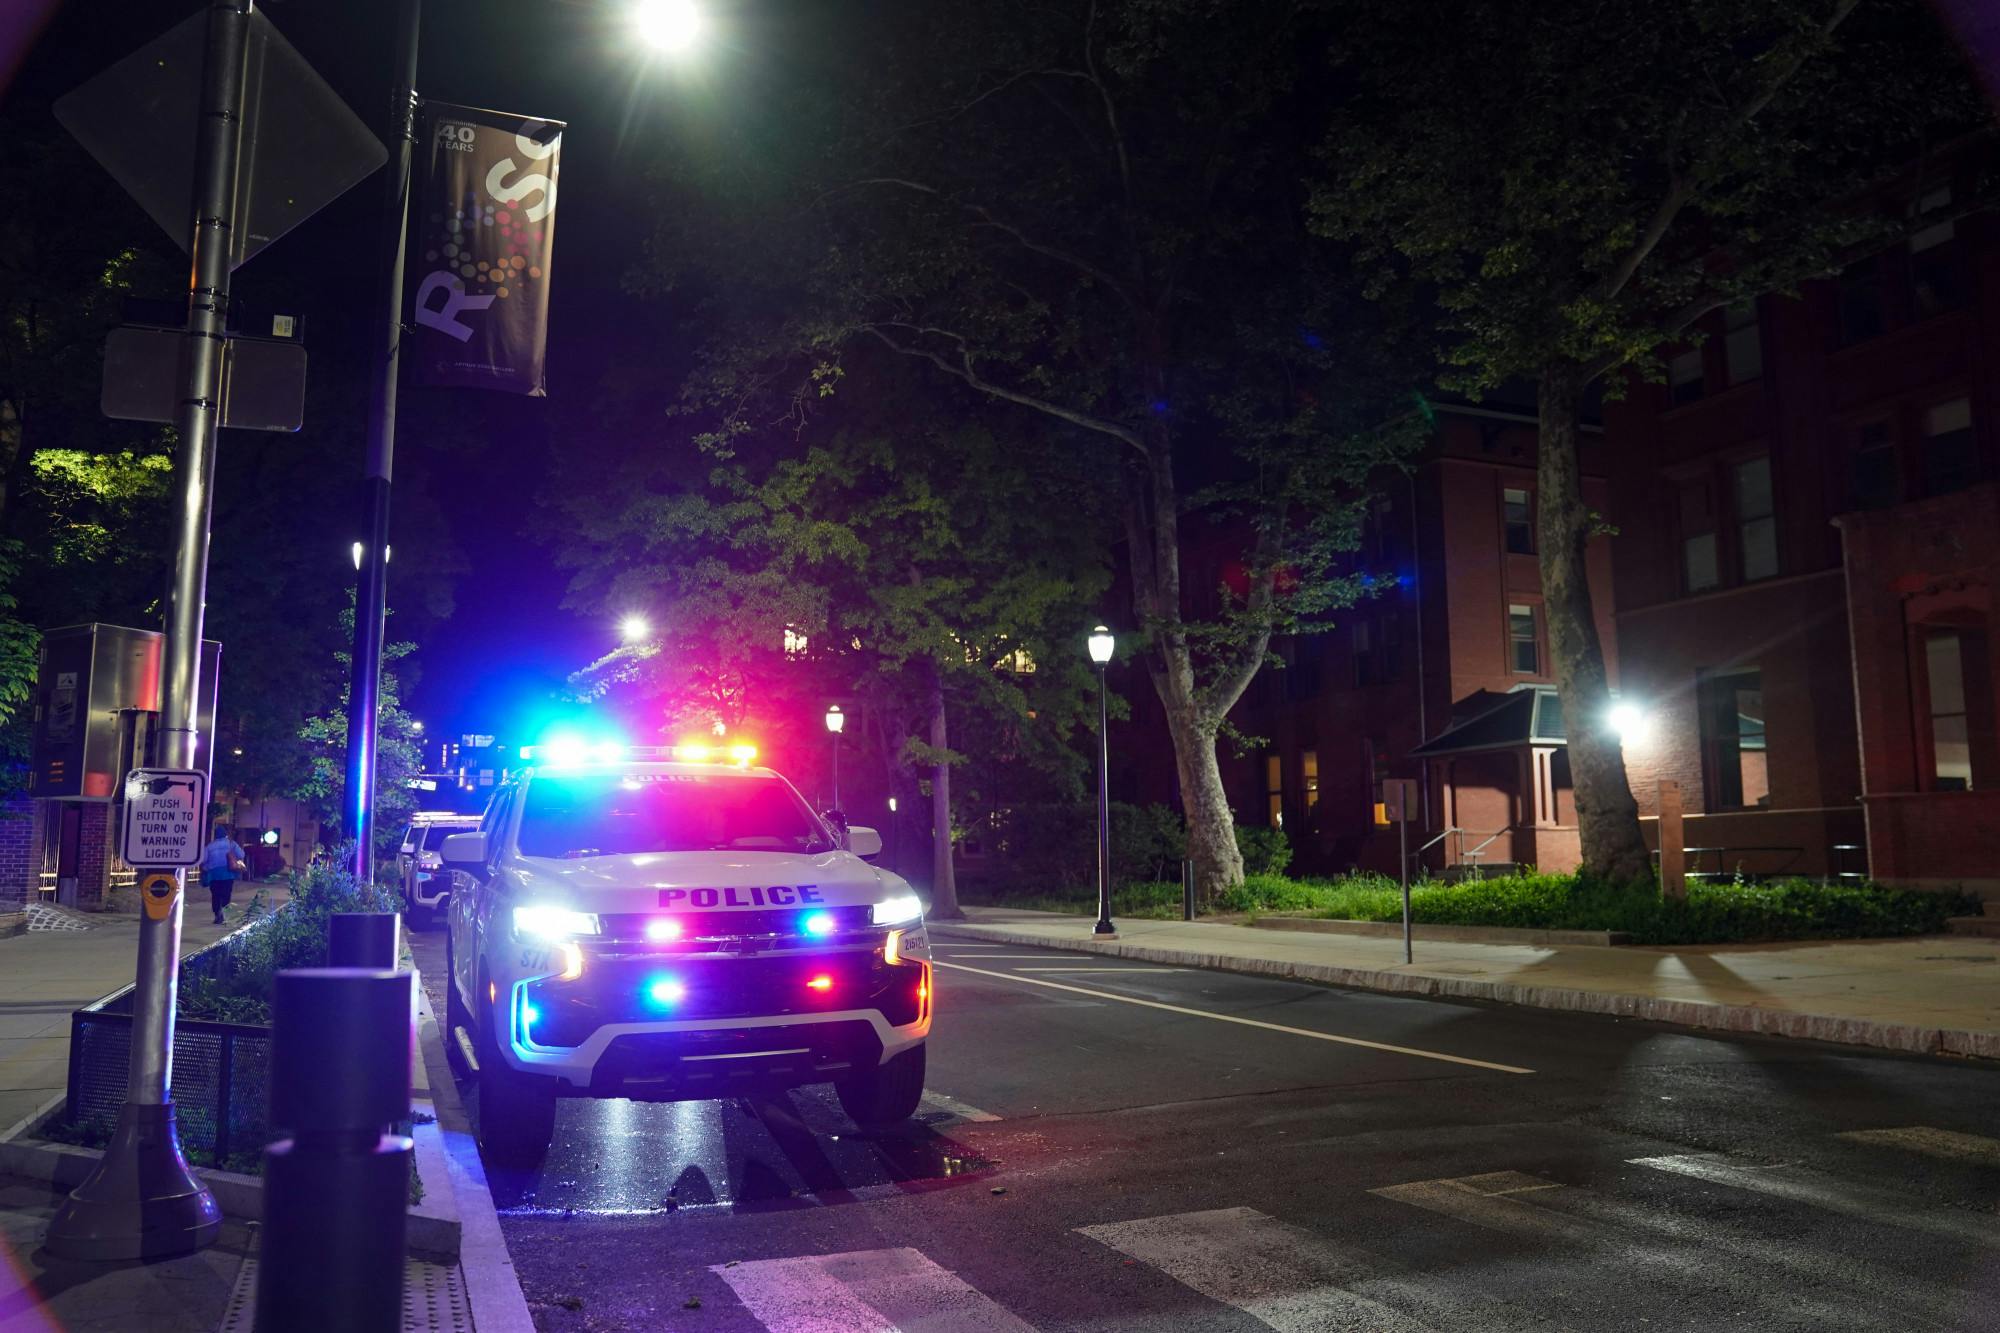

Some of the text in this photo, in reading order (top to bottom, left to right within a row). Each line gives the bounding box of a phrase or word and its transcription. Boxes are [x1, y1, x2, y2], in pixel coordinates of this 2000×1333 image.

[439, 125, 475, 143] 40
[439, 141, 474, 153] YEARS
[152, 799, 180, 808] PUSH
[136, 811, 194, 821] BUTTON TO
[141, 824, 188, 833] TURN ON
[141, 836, 186, 846] WARNING
[145, 849, 180, 858] LIGHTS
[658, 885, 824, 907] POLICE
